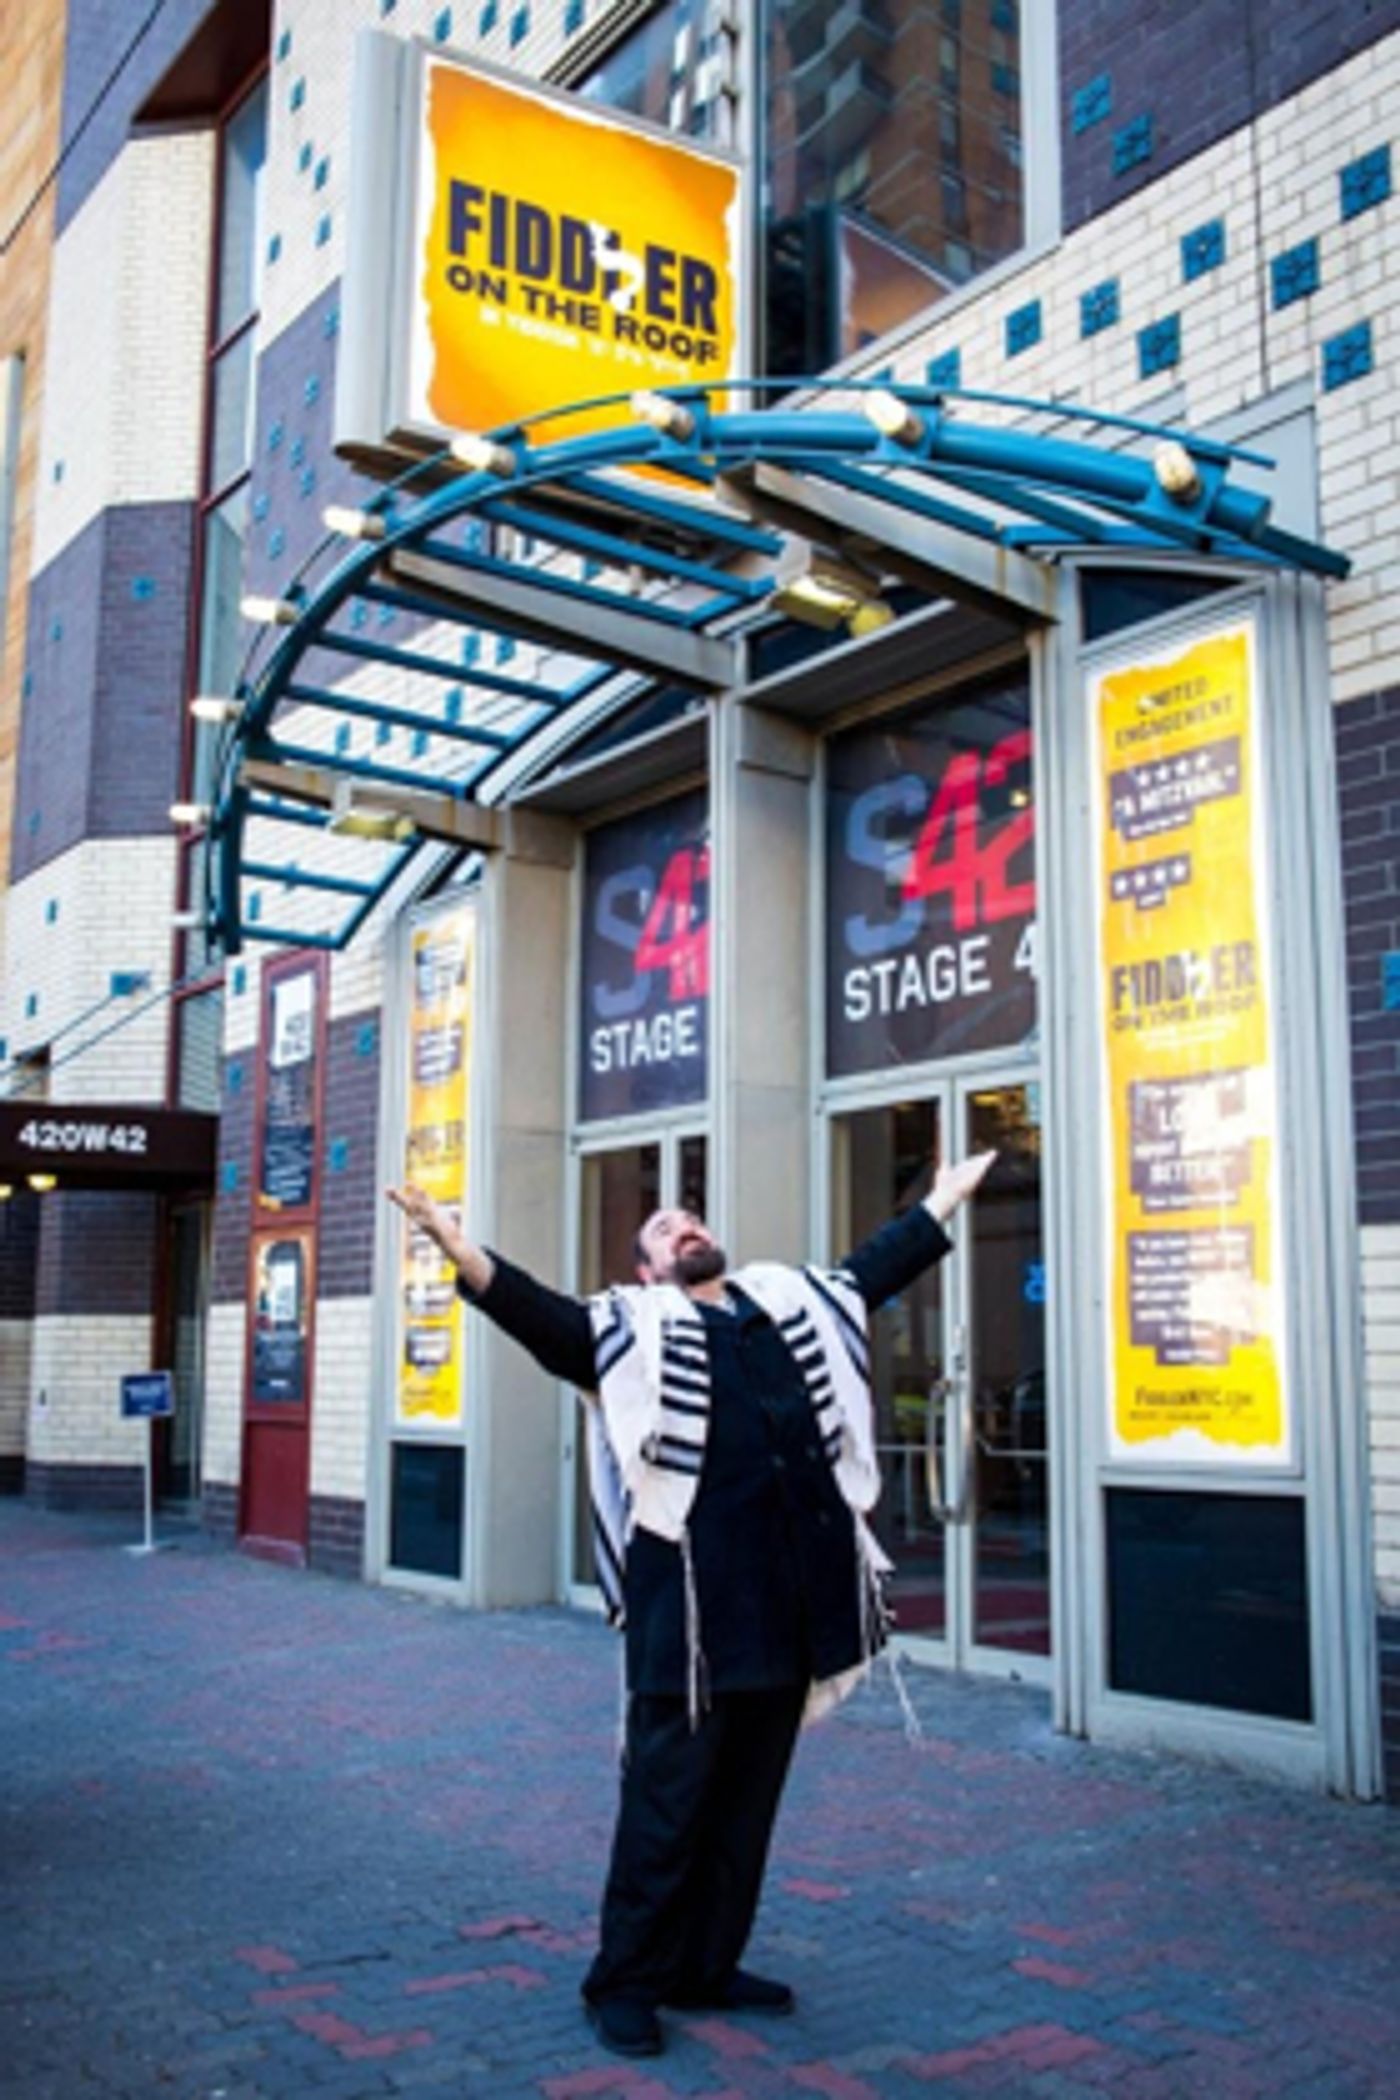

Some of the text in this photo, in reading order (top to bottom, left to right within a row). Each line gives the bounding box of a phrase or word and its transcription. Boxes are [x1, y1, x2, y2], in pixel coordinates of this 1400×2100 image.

[446, 263, 508, 306] ON
[519, 283, 601, 334] THE
[613, 312, 719, 366] ROOF
[844, 933, 991, 1022] STAGE
[590, 1005, 698, 1072] STAGE
